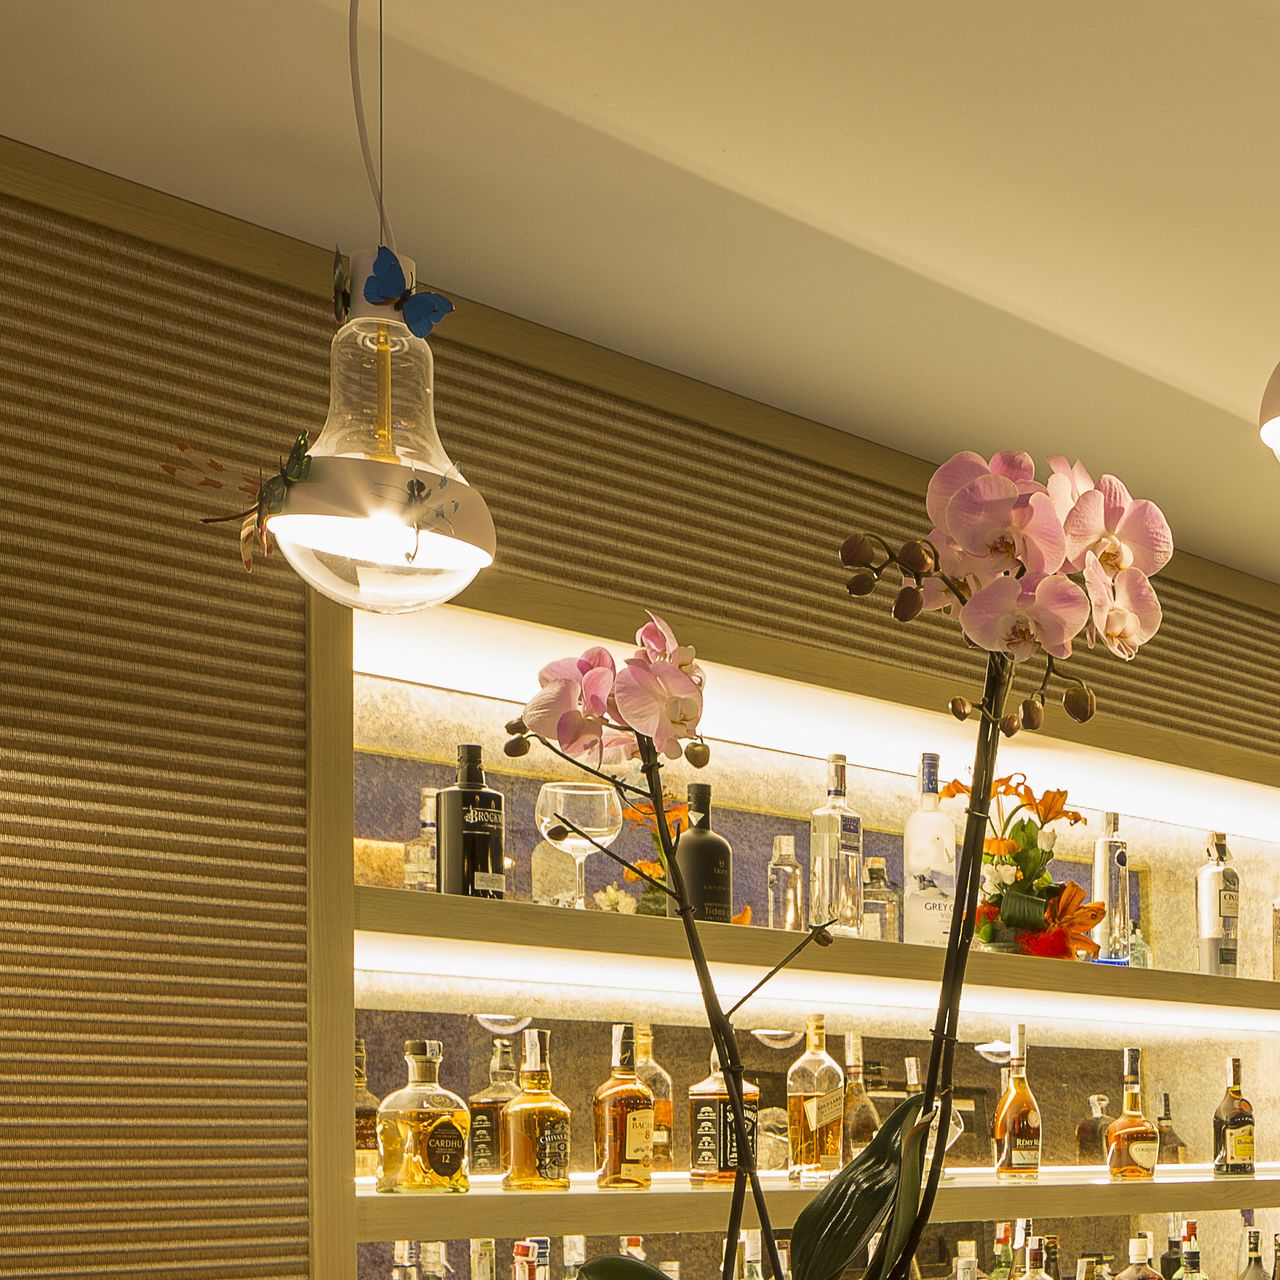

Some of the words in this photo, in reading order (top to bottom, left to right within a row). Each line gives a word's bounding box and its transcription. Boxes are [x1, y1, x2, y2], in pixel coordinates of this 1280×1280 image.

[924, 902, 942, 911] GREY
[429, 1138, 463, 1149] CARDHU
[442, 1155, 451, 1163] 12
